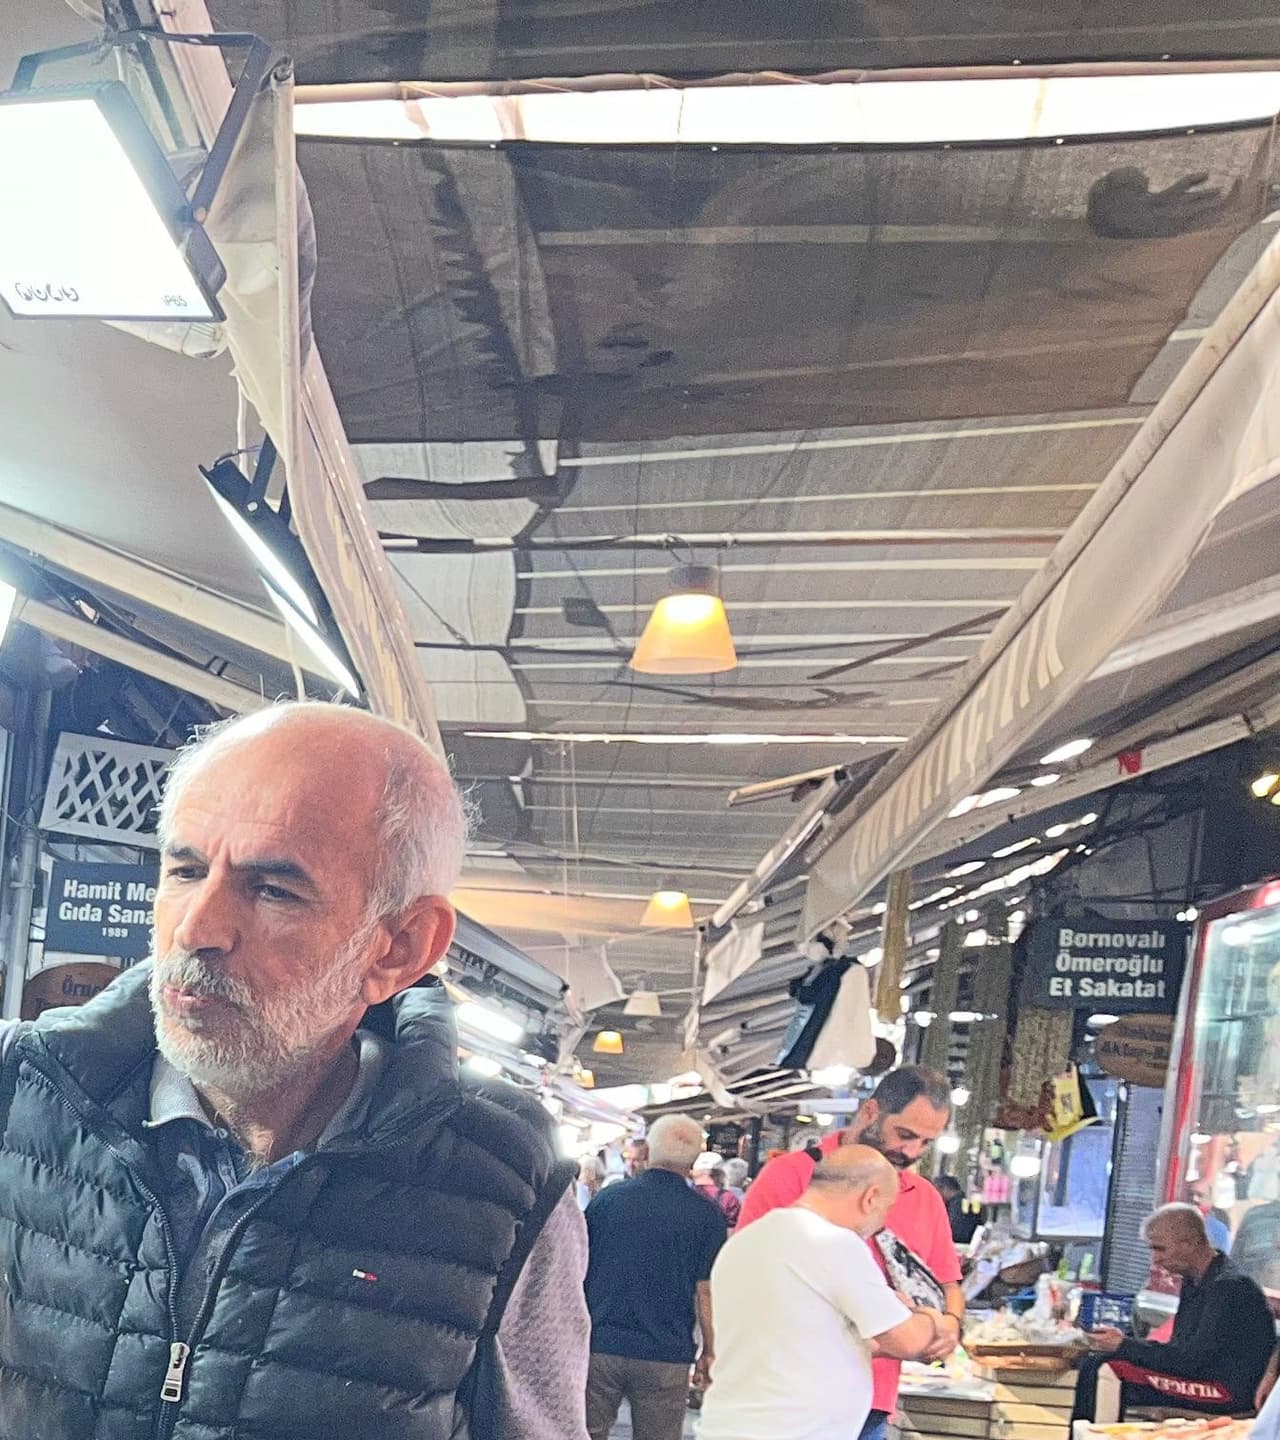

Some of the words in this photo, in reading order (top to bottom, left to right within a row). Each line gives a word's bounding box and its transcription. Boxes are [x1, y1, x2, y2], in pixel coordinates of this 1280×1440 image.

[64, 879, 122, 900] Hamit
[127, 883, 157, 902] Me
[59, 902, 102, 922] Gıda
[108, 904, 154, 925] Sana
[102, 927, 128, 938] 1989
[1059, 928, 1166, 948] Bornovalı
[1056, 949, 1164, 977] Ömeroğlu
[1049, 977, 1072, 996] Et
[1079, 978, 1166, 998] Sakatat
